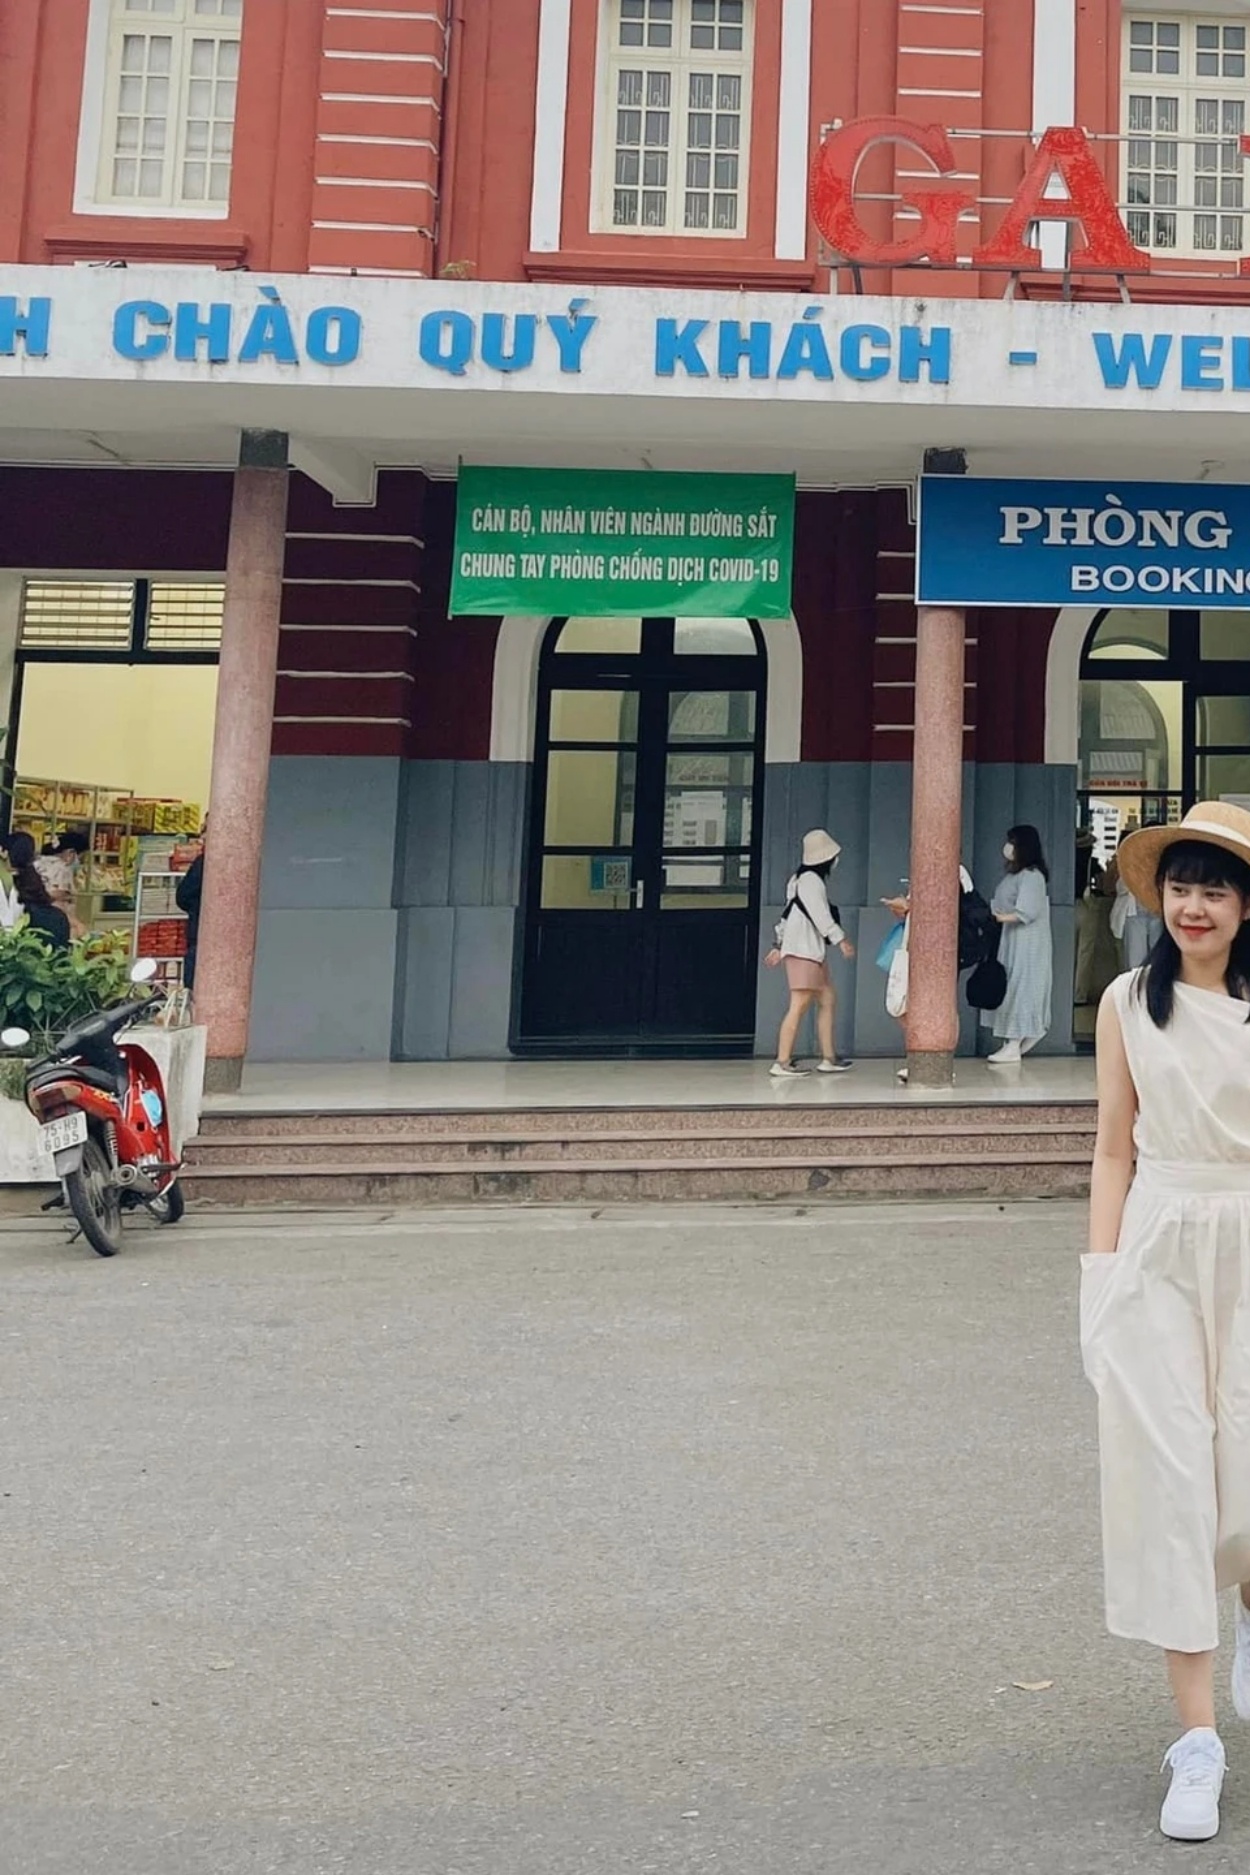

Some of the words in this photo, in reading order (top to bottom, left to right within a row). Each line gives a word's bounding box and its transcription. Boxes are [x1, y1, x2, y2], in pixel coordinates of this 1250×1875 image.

[811, 115, 1151, 269] GA
[112, 286, 361, 367] CHÀO
[418, 298, 597, 375] QUÝ
[655, 306, 951, 384] KHÁCH
[1009, 352, 1037, 366] -
[472, 503, 506, 532] CÁN
[509, 504, 535, 538] BỘ,
[540, 505, 586, 534] NHÂN
[590, 506, 626, 535] VIÊN
[631, 507, 685, 536] NGÀNH
[690, 508, 743, 538] ĐƯỜNG
[747, 506, 777, 538] SẮT
[1000, 493, 1233, 549] PHÒNG
[460, 552, 516, 578] CHUNG
[520, 554, 546, 579] TAY
[550, 548, 604, 580] PHÒNG
[609, 548, 663, 581] CHỐNG
[668, 557, 704, 586] DỊCH
[709, 558, 779, 582] COVID-19
[44, 1117, 78, 1138] 75-H9
[45, 1130, 79, 1152] 6095
